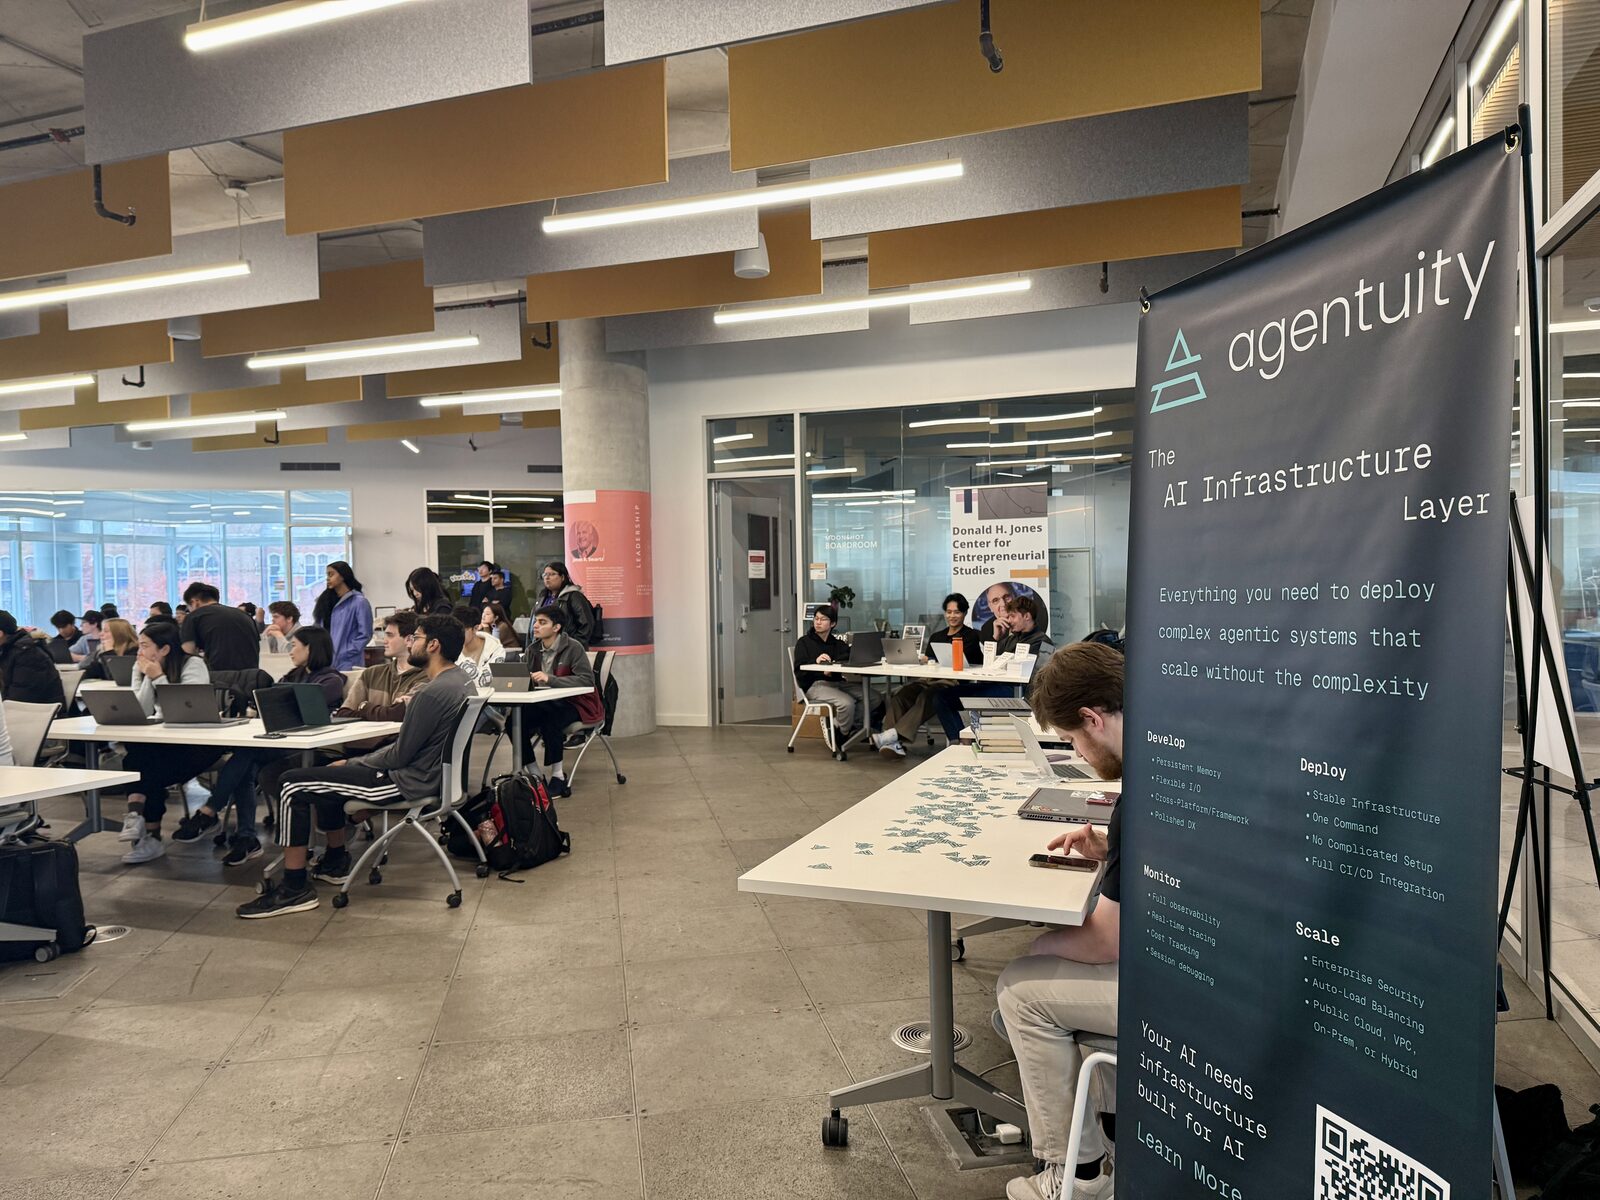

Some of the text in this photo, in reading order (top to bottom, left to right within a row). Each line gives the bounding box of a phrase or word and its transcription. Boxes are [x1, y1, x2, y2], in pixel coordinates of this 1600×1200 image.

[1228, 240, 1496, 380] agentuity
[1149, 449, 1175, 468] The
[1164, 444, 1431, 507] AI Infrastructure
[1405, 493, 1489, 522] Layer
[952, 524, 1042, 536] Donald H. Jones
[952, 538, 1011, 549] Center for
[825, 541, 877, 550] BOARDROOM
[953, 550, 1045, 564] Entrepreneurial
[953, 565, 995, 575] Studies
[1160, 580, 1434, 604] Everything you need to deploy
[1159, 625, 1420, 647] complex agentic systems that
[1162, 662, 1428, 700] scale without the complexity
[1148, 731, 1185, 749] Develop
[1157, 757, 1221, 779] Persistent Memory
[1301, 758, 1346, 781] Deploy
[1156, 775, 1201, 792] Flexible I/O
[1155, 811, 1196, 830] Polished DX
[1156, 793, 1248, 824] Cross-Platform/Framework
[1313, 790, 1440, 824] Stable Infrastructure
[1313, 812, 1378, 834] One Command
[1313, 835, 1432, 873] No Complicated Setup
[1144, 865, 1181, 888] Monitor
[1313, 857, 1444, 901] Full CI/CD Integration
[1153, 893, 1220, 928] Full observability
[1152, 911, 1215, 946] Real-time tracing
[1296, 922, 1339, 946] Scale
[1151, 929, 1199, 959] Cost Tracking
[1151, 947, 1214, 986] Session debugging
[1312, 956, 1424, 1008] Enterprise Security
[1313, 979, 1424, 1034] Auto-Load Balancing
[1314, 1000, 1415, 1055] Public Cloud, VPC,
[1142, 1020, 1253, 1099] Your AI needs
[1314, 1022, 1417, 1078] On-Prem, or Hybrid
[1140, 1052, 1266, 1138] infrastructure
[1138, 1079, 1244, 1160] built for AI
[1137, 1121, 1241, 1200] Learn More
